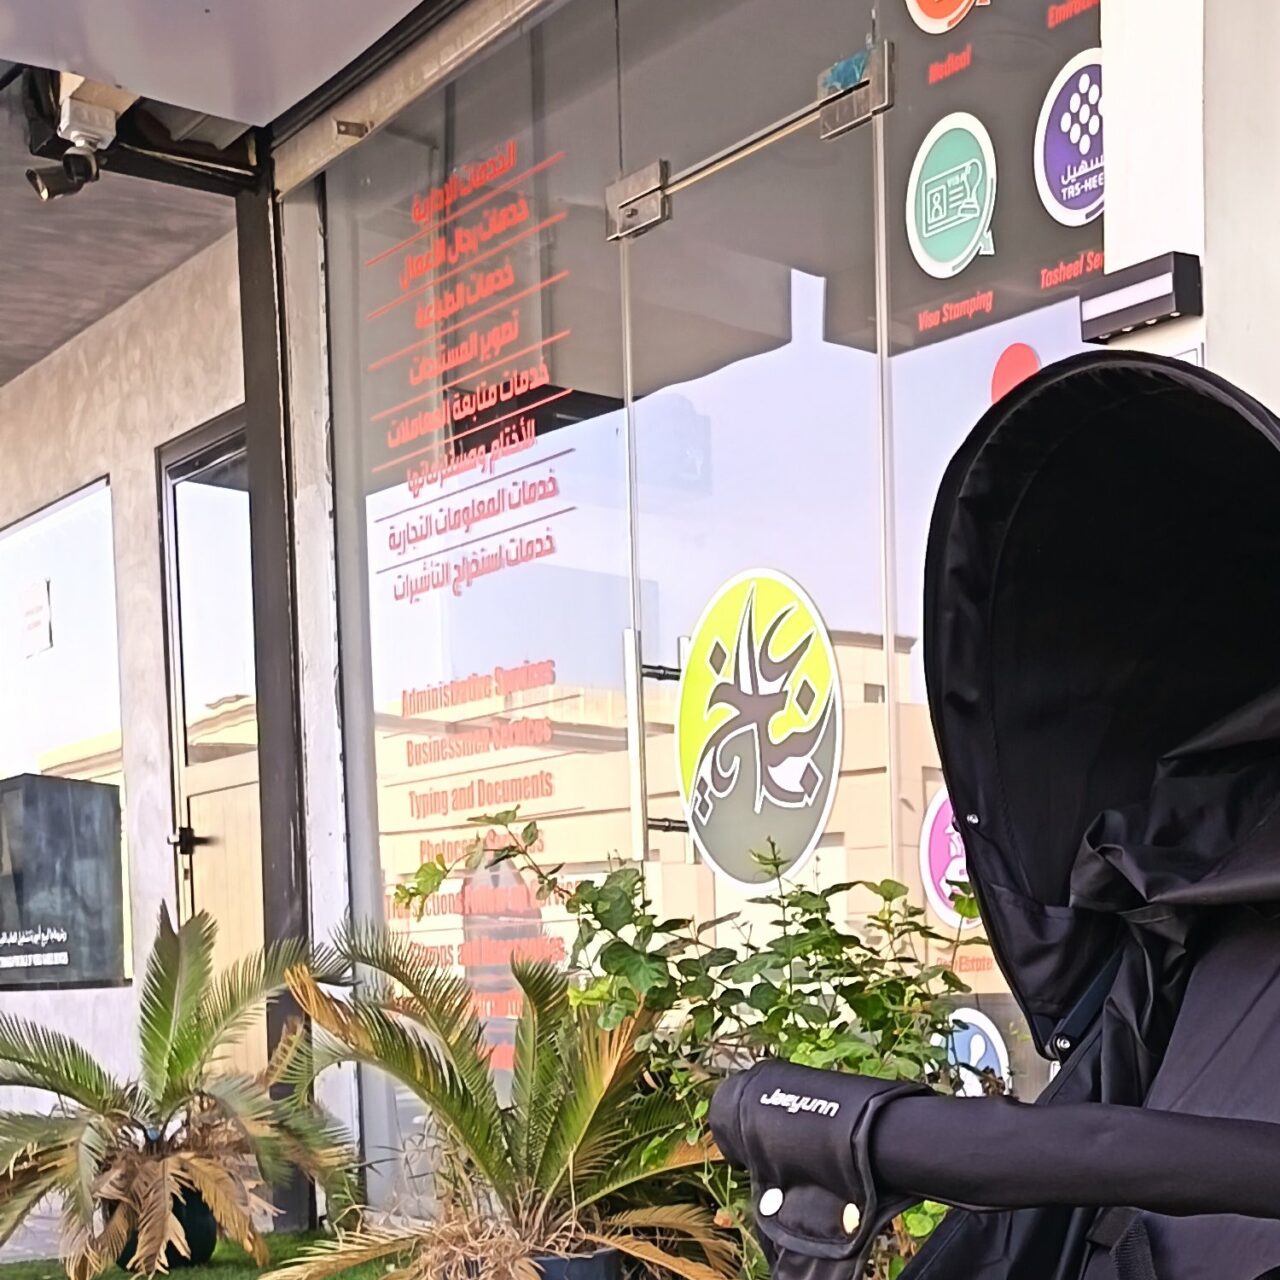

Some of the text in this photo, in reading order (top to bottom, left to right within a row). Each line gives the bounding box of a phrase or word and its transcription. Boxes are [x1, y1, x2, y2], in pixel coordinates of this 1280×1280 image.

[1060, 153, 1104, 185] سهيل
[1060, 172, 1104, 201] TAS-HEE
[1041, 252, 1085, 290] Tasheel
[918, 289, 994, 332] Visa Stamping
[499, 356, 550, 402] خدمات
[452, 380, 498, 422] متابعة
[488, 416, 537, 474] الأختام
[388, 468, 560, 556] خدمات المعلومات التجارية
[504, 526, 557, 568] خدمات
[452, 543, 505, 598] استخراج
[401, 672, 494, 719] Administrative
[406, 727, 492, 768] Businessmen
[408, 770, 554, 820] Typing and Documents
